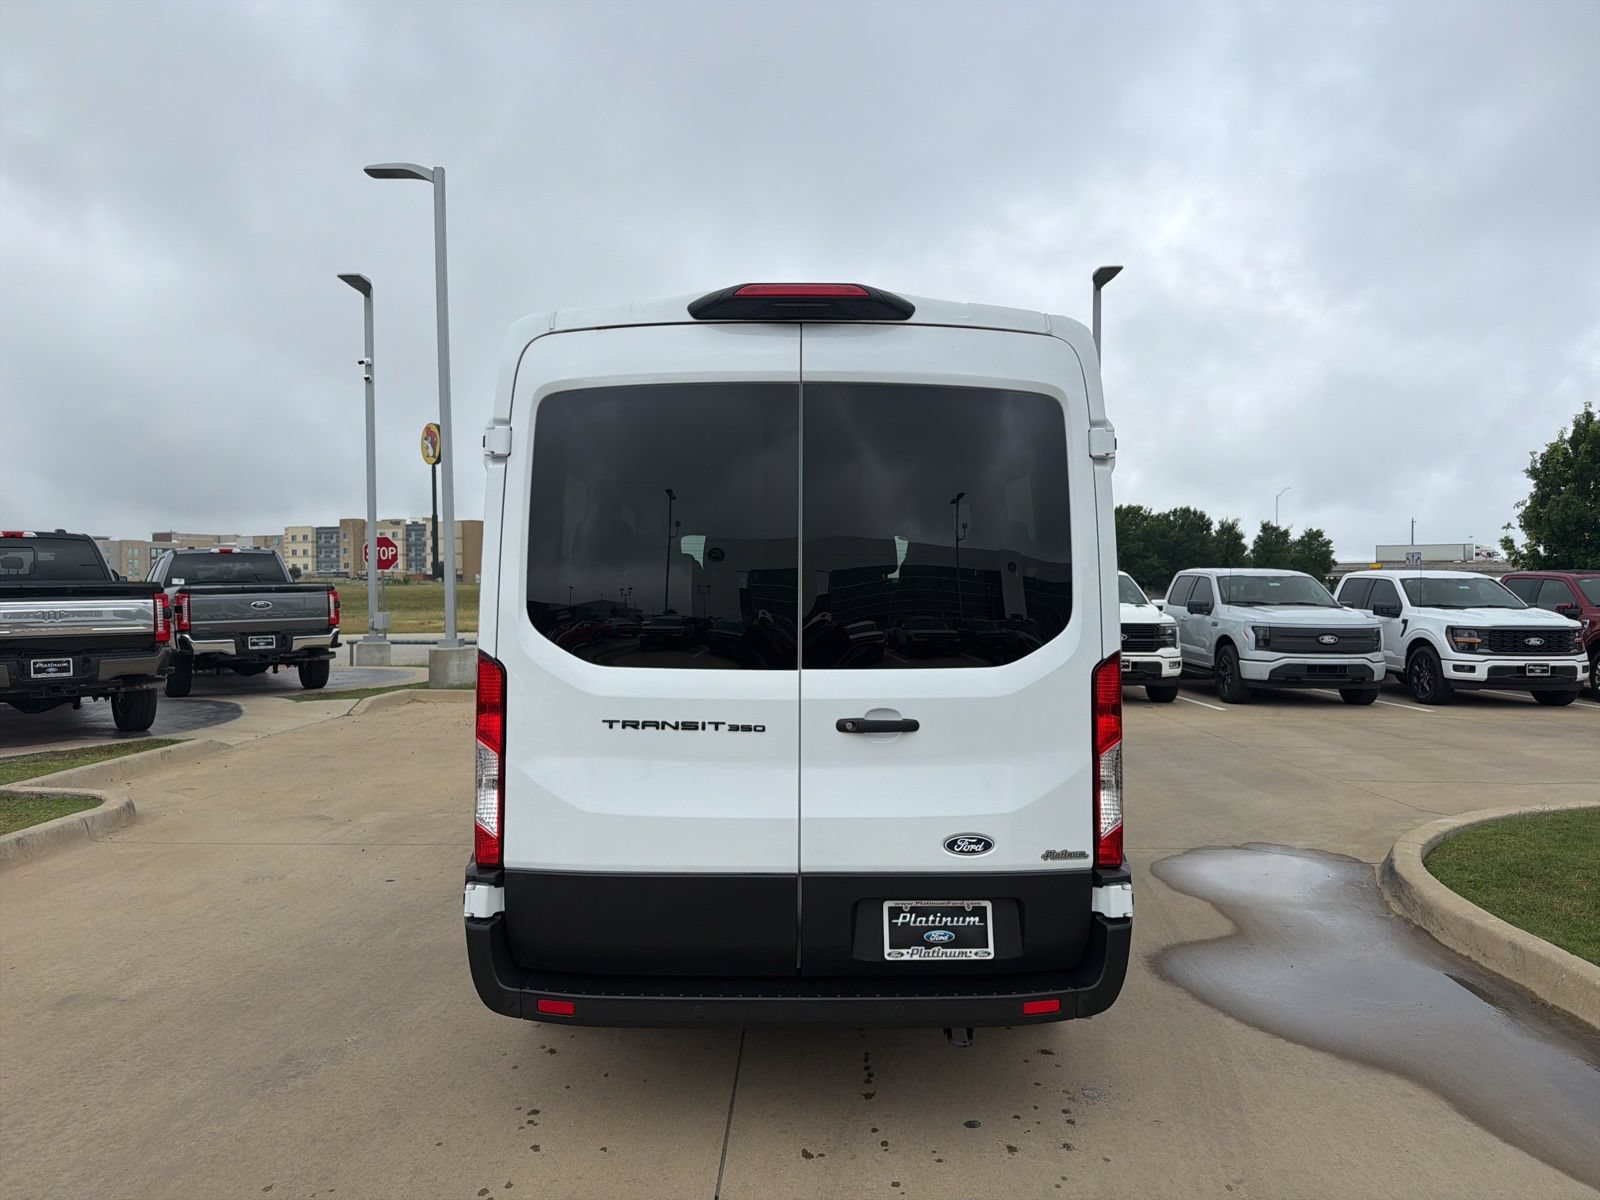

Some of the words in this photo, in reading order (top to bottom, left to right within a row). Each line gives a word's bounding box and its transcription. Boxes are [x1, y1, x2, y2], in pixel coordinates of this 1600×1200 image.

[366, 547, 396, 560] TOP
[953, 838, 985, 852] Ford
[1041, 850, 1090, 861] Platinum
[892, 913, 985, 927] Platinum
[909, 946, 972, 959] Platinum
